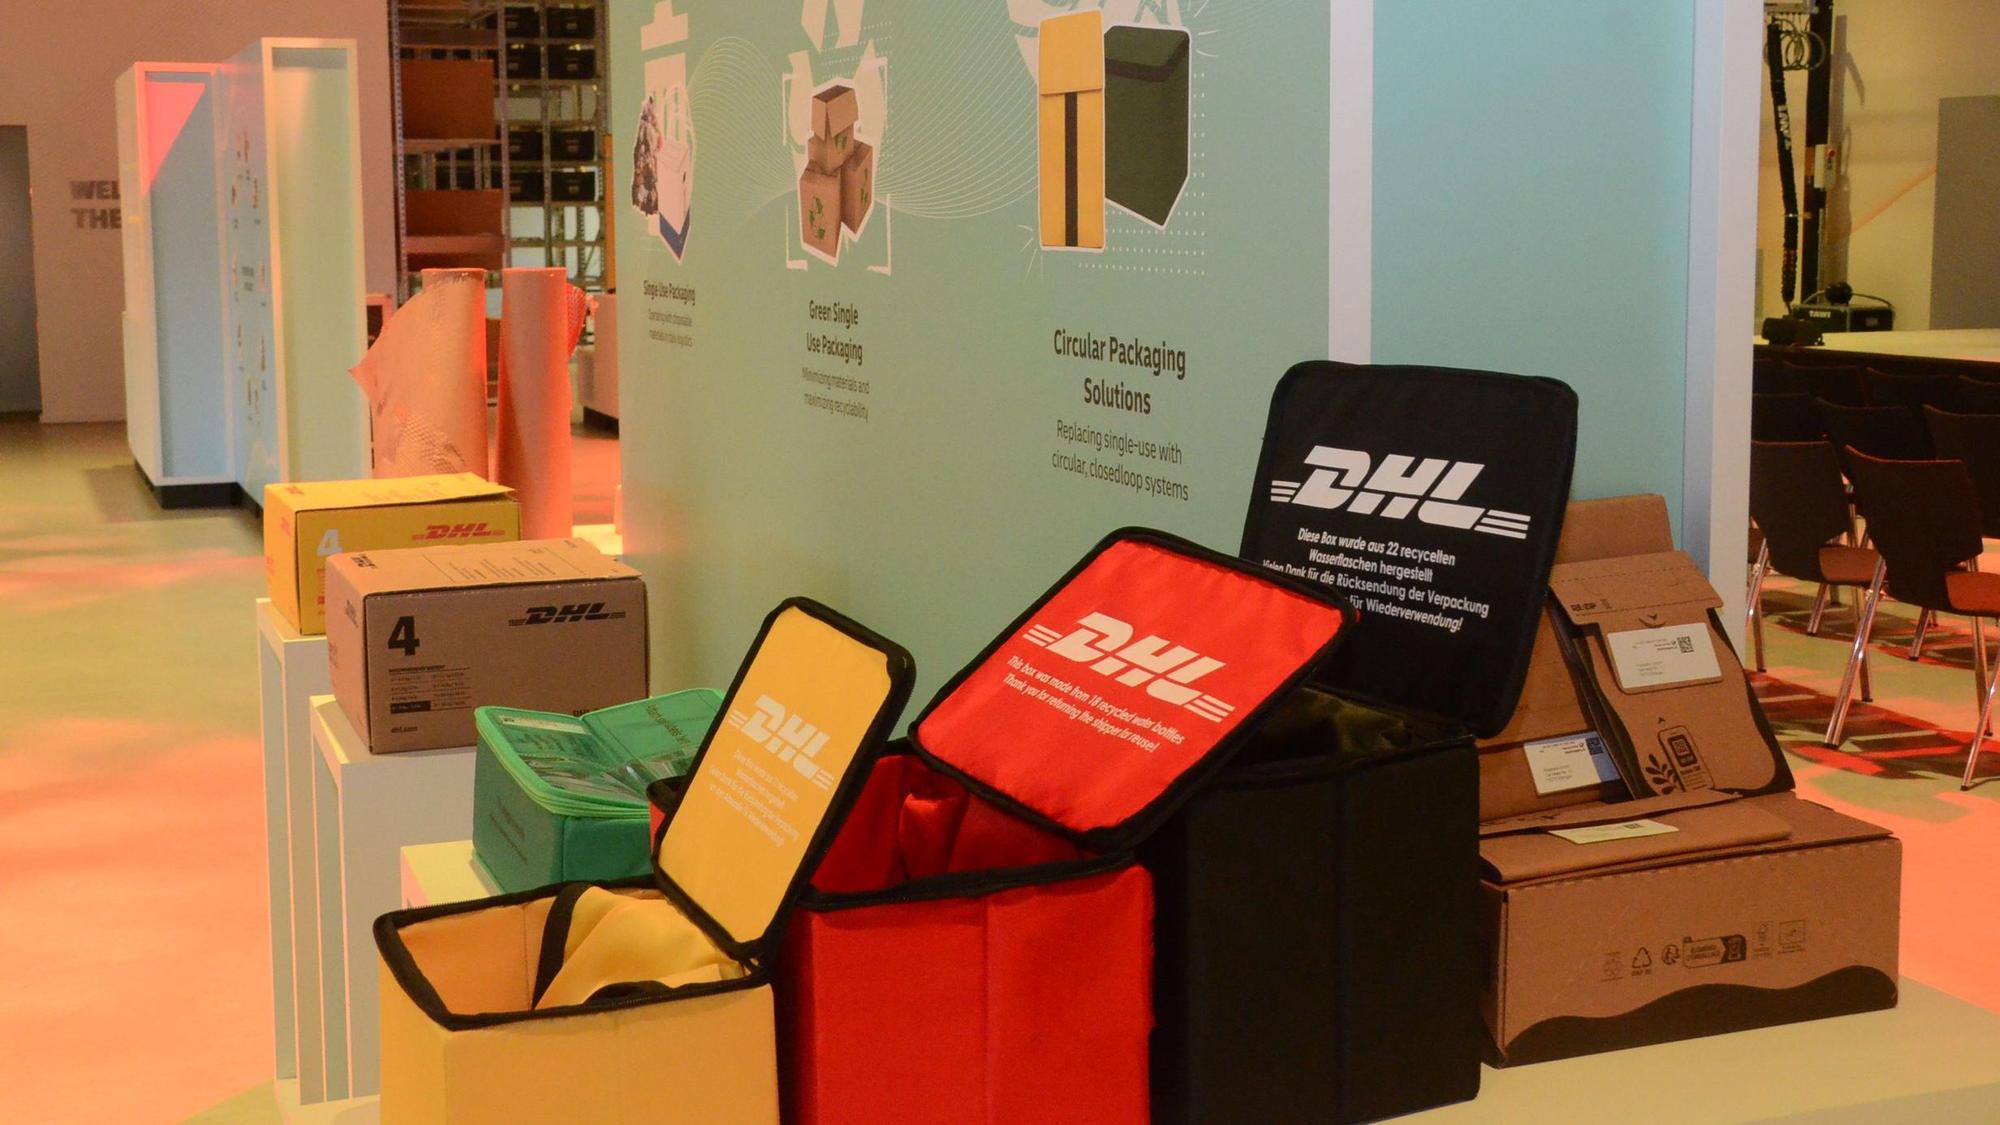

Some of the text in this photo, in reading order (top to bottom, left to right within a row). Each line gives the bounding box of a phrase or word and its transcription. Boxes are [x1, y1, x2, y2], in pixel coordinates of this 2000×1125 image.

[70, 208, 121, 228] THE
[669, 282, 695, 306] Packaging
[809, 300, 859, 328] Green Single
[1808, 310, 1831, 318] TAWI
[806, 332, 864, 366] Use Packaging
[1054, 329, 1186, 380] Circular Packaging
[1084, 377, 1151, 415] Solutions
[1056, 419, 1182, 465] Replacing single-use with
[1052, 449, 1189, 501] circular, closedloop systems
[1291, 445, 1485, 530] DHL
[316, 528, 343, 556] 4
[426, 522, 491, 539] DHL
[1297, 528, 1455, 566] Diese Box wurde aus 22 recycelten
[1309, 548, 1434, 583] Wasserflaschen hergestellt
[1285, 563, 1307, 577] Dank
[1306, 567, 1320, 581] für
[1319, 569, 1335, 585] die
[1336, 572, 1406, 600] Rücksendung
[1408, 584, 1426, 602] der
[1427, 590, 1490, 618] Verpackung
[525, 602, 611, 625] DHL
[1365, 599, 1463, 633] Wiederverwendung!
[387, 616, 420, 656] 4
[1046, 611, 1227, 706] DHL
[1002, 672, 1028, 691] Thank
[1020, 685, 1041, 698] you
[1037, 689, 1052, 701] for
[1046, 695, 1082, 720] returning
[1078, 710, 1094, 724] the
[1092, 717, 1122, 736] shipper
[1127, 733, 1161, 752] reuse!
[1007, 655, 1024, 669] This
[1020, 662, 1038, 677] box
[1034, 670, 1051, 683] was
[1048, 677, 1073, 693] made
[1069, 686, 1091, 703] from
[1095, 700, 1136, 722] recycled
[1131, 715, 1156, 728] water
[1151, 721, 1185, 745] bottles
[741, 694, 831, 780] DHL
